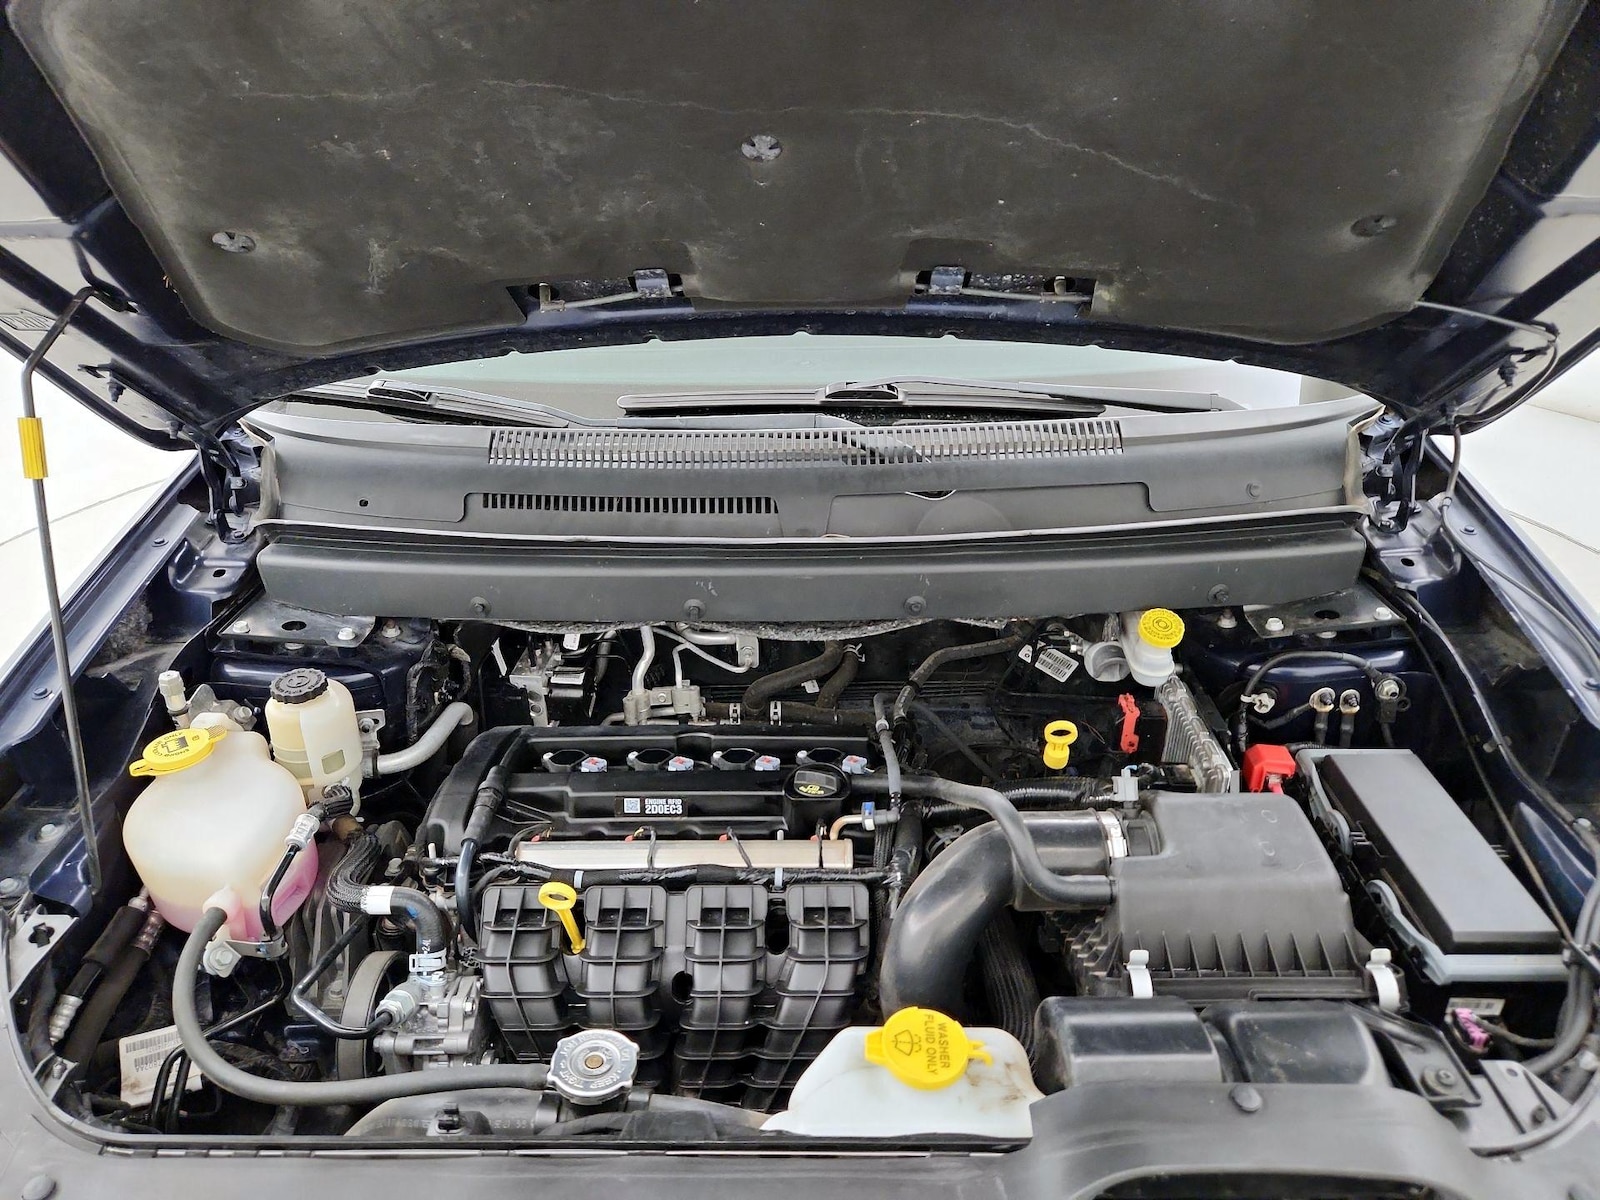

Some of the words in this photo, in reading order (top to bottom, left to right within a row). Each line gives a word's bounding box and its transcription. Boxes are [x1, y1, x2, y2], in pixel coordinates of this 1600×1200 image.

[645, 804, 682, 814] 2D0EC3
[924, 1014, 936, 1044] FLUID
[938, 1022, 950, 1068] WASHER
[926, 1047, 939, 1076] ONLY
